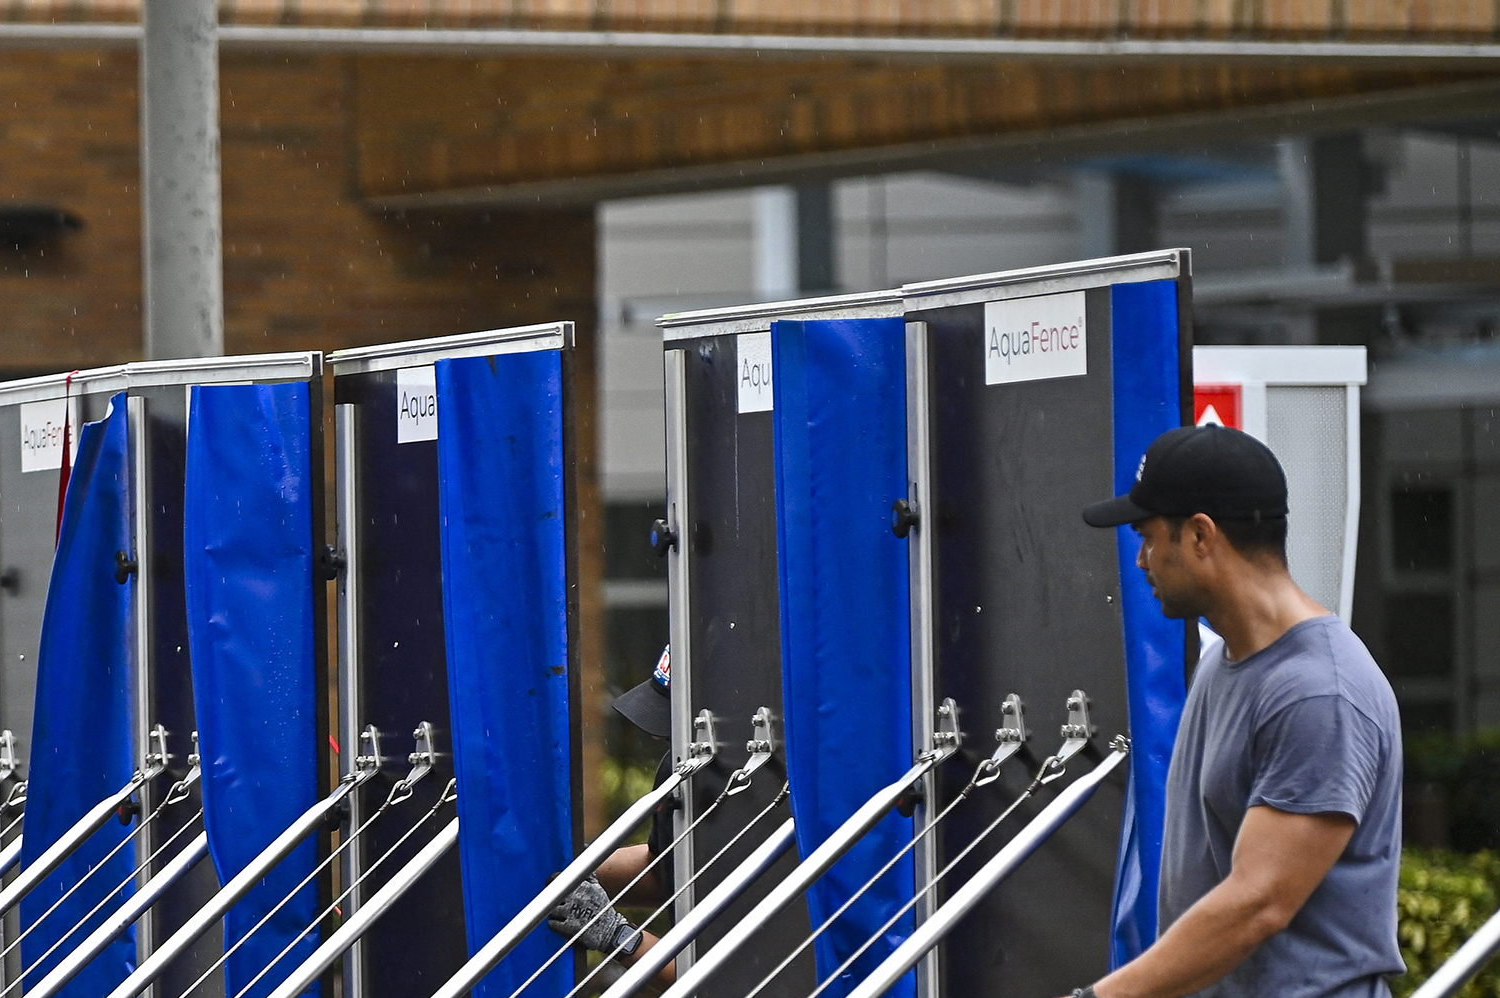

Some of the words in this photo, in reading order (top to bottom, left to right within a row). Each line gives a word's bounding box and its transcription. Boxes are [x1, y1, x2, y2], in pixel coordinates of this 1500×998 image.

[741, 357, 771, 395] Aqu
[400, 391, 435, 426] Aqua
[23, 421, 73, 456] AquaFene
